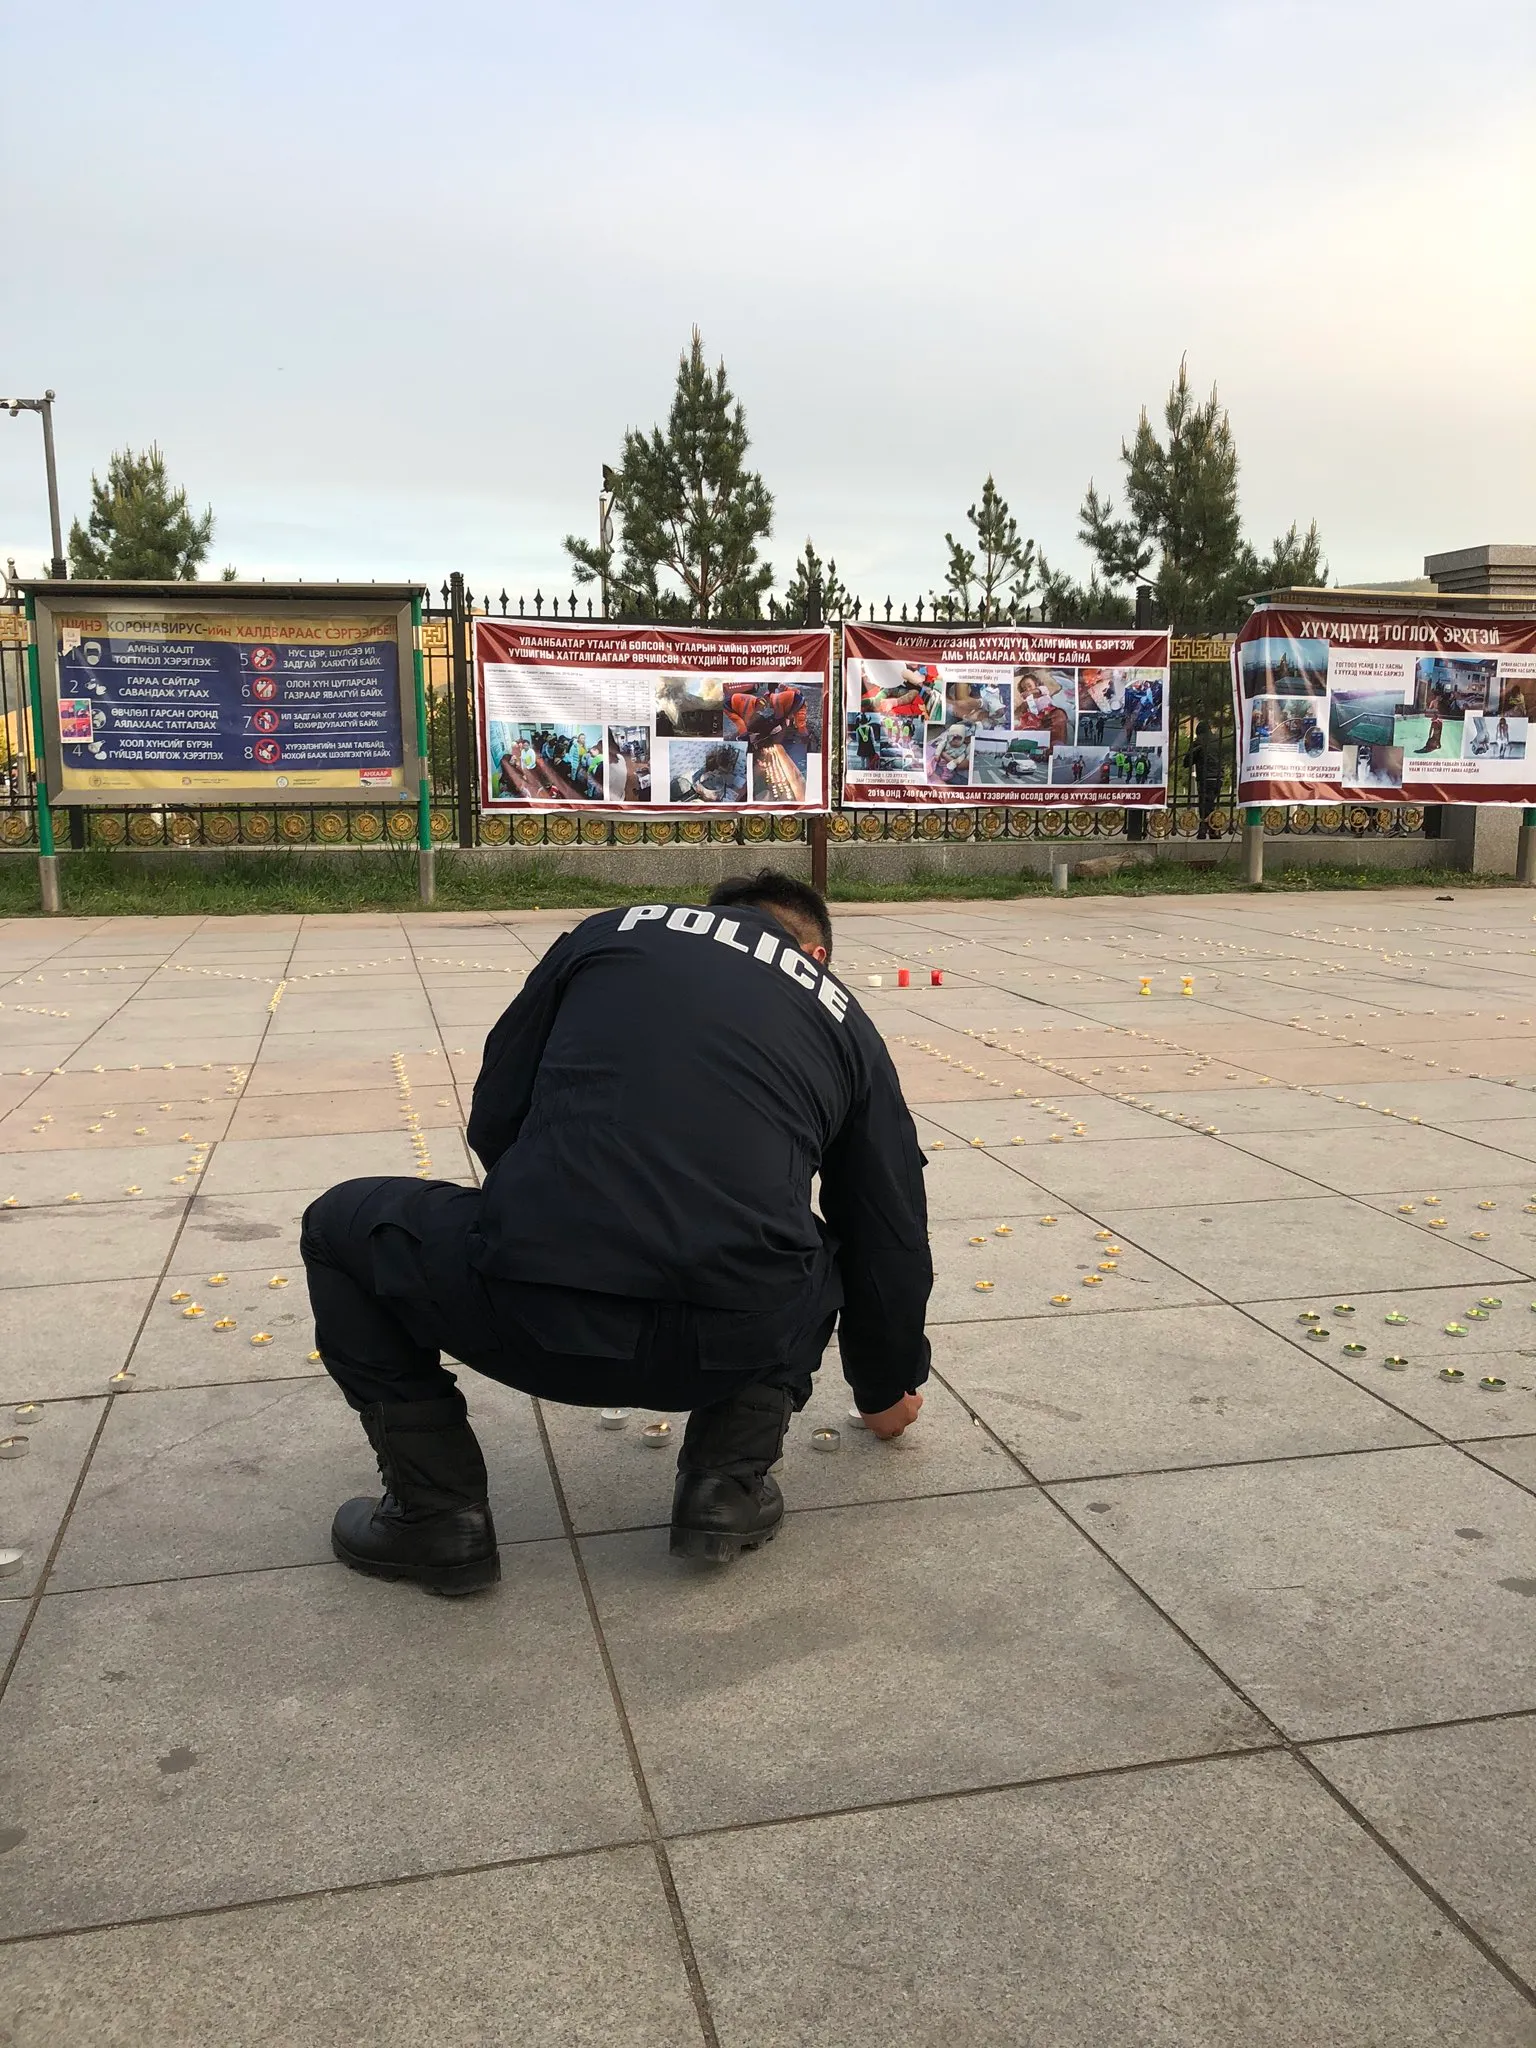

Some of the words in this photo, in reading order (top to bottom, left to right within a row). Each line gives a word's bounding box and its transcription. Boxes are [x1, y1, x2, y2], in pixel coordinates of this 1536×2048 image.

[236, 626, 322, 639] ХАЛДВАРААС
[1300, 621, 1379, 643] ХҮҮХДҮҮД
[1382, 624, 1439, 642] ТОГЛОХ
[1443, 627, 1500, 645] ЭРХТЭЙ
[127, 644, 159, 654] АМНЫ
[162, 645, 194, 654] ХААЛТ
[519, 636, 585, 649] УЛААНБААТАР
[587, 638, 627, 650] УТААГҮЙ
[629, 640, 665, 651] БОЛСОН
[666, 642, 672, 651] Ч
[674, 642, 716, 653] УГААРЫН
[718, 642, 749, 654] ХИЙНД
[750, 643, 792, 655] ХОРДСОН,
[896, 636, 931, 648] АХУЙН
[930, 638, 976, 650] ХҮРЭЭНД
[979, 637, 1029, 649] ХҮҮХДҮҮД
[1031, 638, 1077, 650] ХАМГИЙН
[1080, 639, 1093, 650] ИХ
[1095, 639, 1135, 651] БЭРТЭЖ
[364, 647, 376, 656] ИЛ
[508, 648, 554, 660] УУШИГНЫ
[556, 649, 630, 662] ХАТГАЛГААГААР
[632, 653, 679, 664] ӨВЧИЛСӨН
[681, 654, 728, 667] ХҮҮХДИЙН
[730, 656, 748, 666] ТОО
[750, 656, 802, 667] НЭМЭГДСЭН
[941, 650, 963, 661] АМЬ
[966, 651, 1016, 662] НАСААРАА
[1018, 651, 1056, 663] ХОХИРЧ
[1058, 651, 1091, 663] БАЙНА
[115, 655, 161, 665] ТОГТМОЛ
[164, 657, 212, 667] ХЭРЭГЛЭХ
[240, 653, 249, 666] 5
[283, 660, 317, 669] ЗАДГАЙ
[321, 658, 358, 668] ХАЯХГҮЙ
[360, 657, 381, 666] БАЙХ
[69, 679, 79, 694] 2
[127, 677, 159, 686] ГАРАА
[162, 676, 201, 687] САЙТАР
[286, 679, 311, 688] ОЛОН
[312, 679, 330, 688] ХҮН
[331, 678, 378, 688] ЦУГЛАРСАН
[119, 688, 175, 698] САВАНДАЖ
[178, 689, 210, 698] УГААХ
[241, 684, 251, 698] 6
[284, 691, 321, 700] ГАЗРААР
[322, 689, 359, 699] ЯВАХГҮЙ
[360, 688, 383, 697] БАЙХ
[111, 708, 149, 718] ӨВЧЛӨЛ
[150, 709, 185, 718] ГАРСАН
[187, 710, 219, 719] ОРОНД
[281, 713, 292, 721] ИЛ
[293, 711, 321, 721] ЗАДГАЙ
[322, 711, 337, 720] ХОГ
[338, 711, 359, 720] ХАЯЖ
[360, 710, 388, 718] ОРЧНЫГ
[114, 720, 163, 729] АЯЛАХААС
[165, 721, 216, 730] ТАТГАЛЗАХ
[243, 715, 252, 729] 7
[294, 720, 357, 730] БОХИРДУУЛАХГҮЙ
[359, 719, 379, 728] БАЙХ
[119, 739, 144, 748] ХООЛ
[146, 738, 184, 748] ХҮНСИЙГ
[187, 740, 213, 749] БҮРЭН
[337, 741, 352, 749] ЗАМ
[354, 740, 385, 749] ТАЛБАЙД
[72, 744, 83, 757] 4
[109, 750, 143, 761] ГҮЙЦЭД
[144, 751, 181, 760] БОЛГОЖ
[183, 751, 224, 760] ХЭРЭГЛЭХ
[244, 746, 254, 760] 8
[281, 750, 306, 760] НОХОЙ
[373, 749, 391, 758] БАЙХ
[867, 789, 885, 797] 2019
[886, 790, 901, 798] ОНД
[916, 789, 937, 799] ГАРУЙ
[938, 791, 965, 801] ХҮҮХЭД
[965, 791, 980, 800] ЗАМ
[982, 791, 1019, 801] ТЭЭВРИЙН
[1020, 793, 1043, 802] ОСОЛД
[1045, 792, 1060, 801] ОРЖ
[1070, 792, 1097, 802] ХҮҮХЭД
[1098, 793, 1111, 801] НАС
[1112, 792, 1141, 801] БАРЖЭЭ
[617, 904, 849, 1024] POLICE
